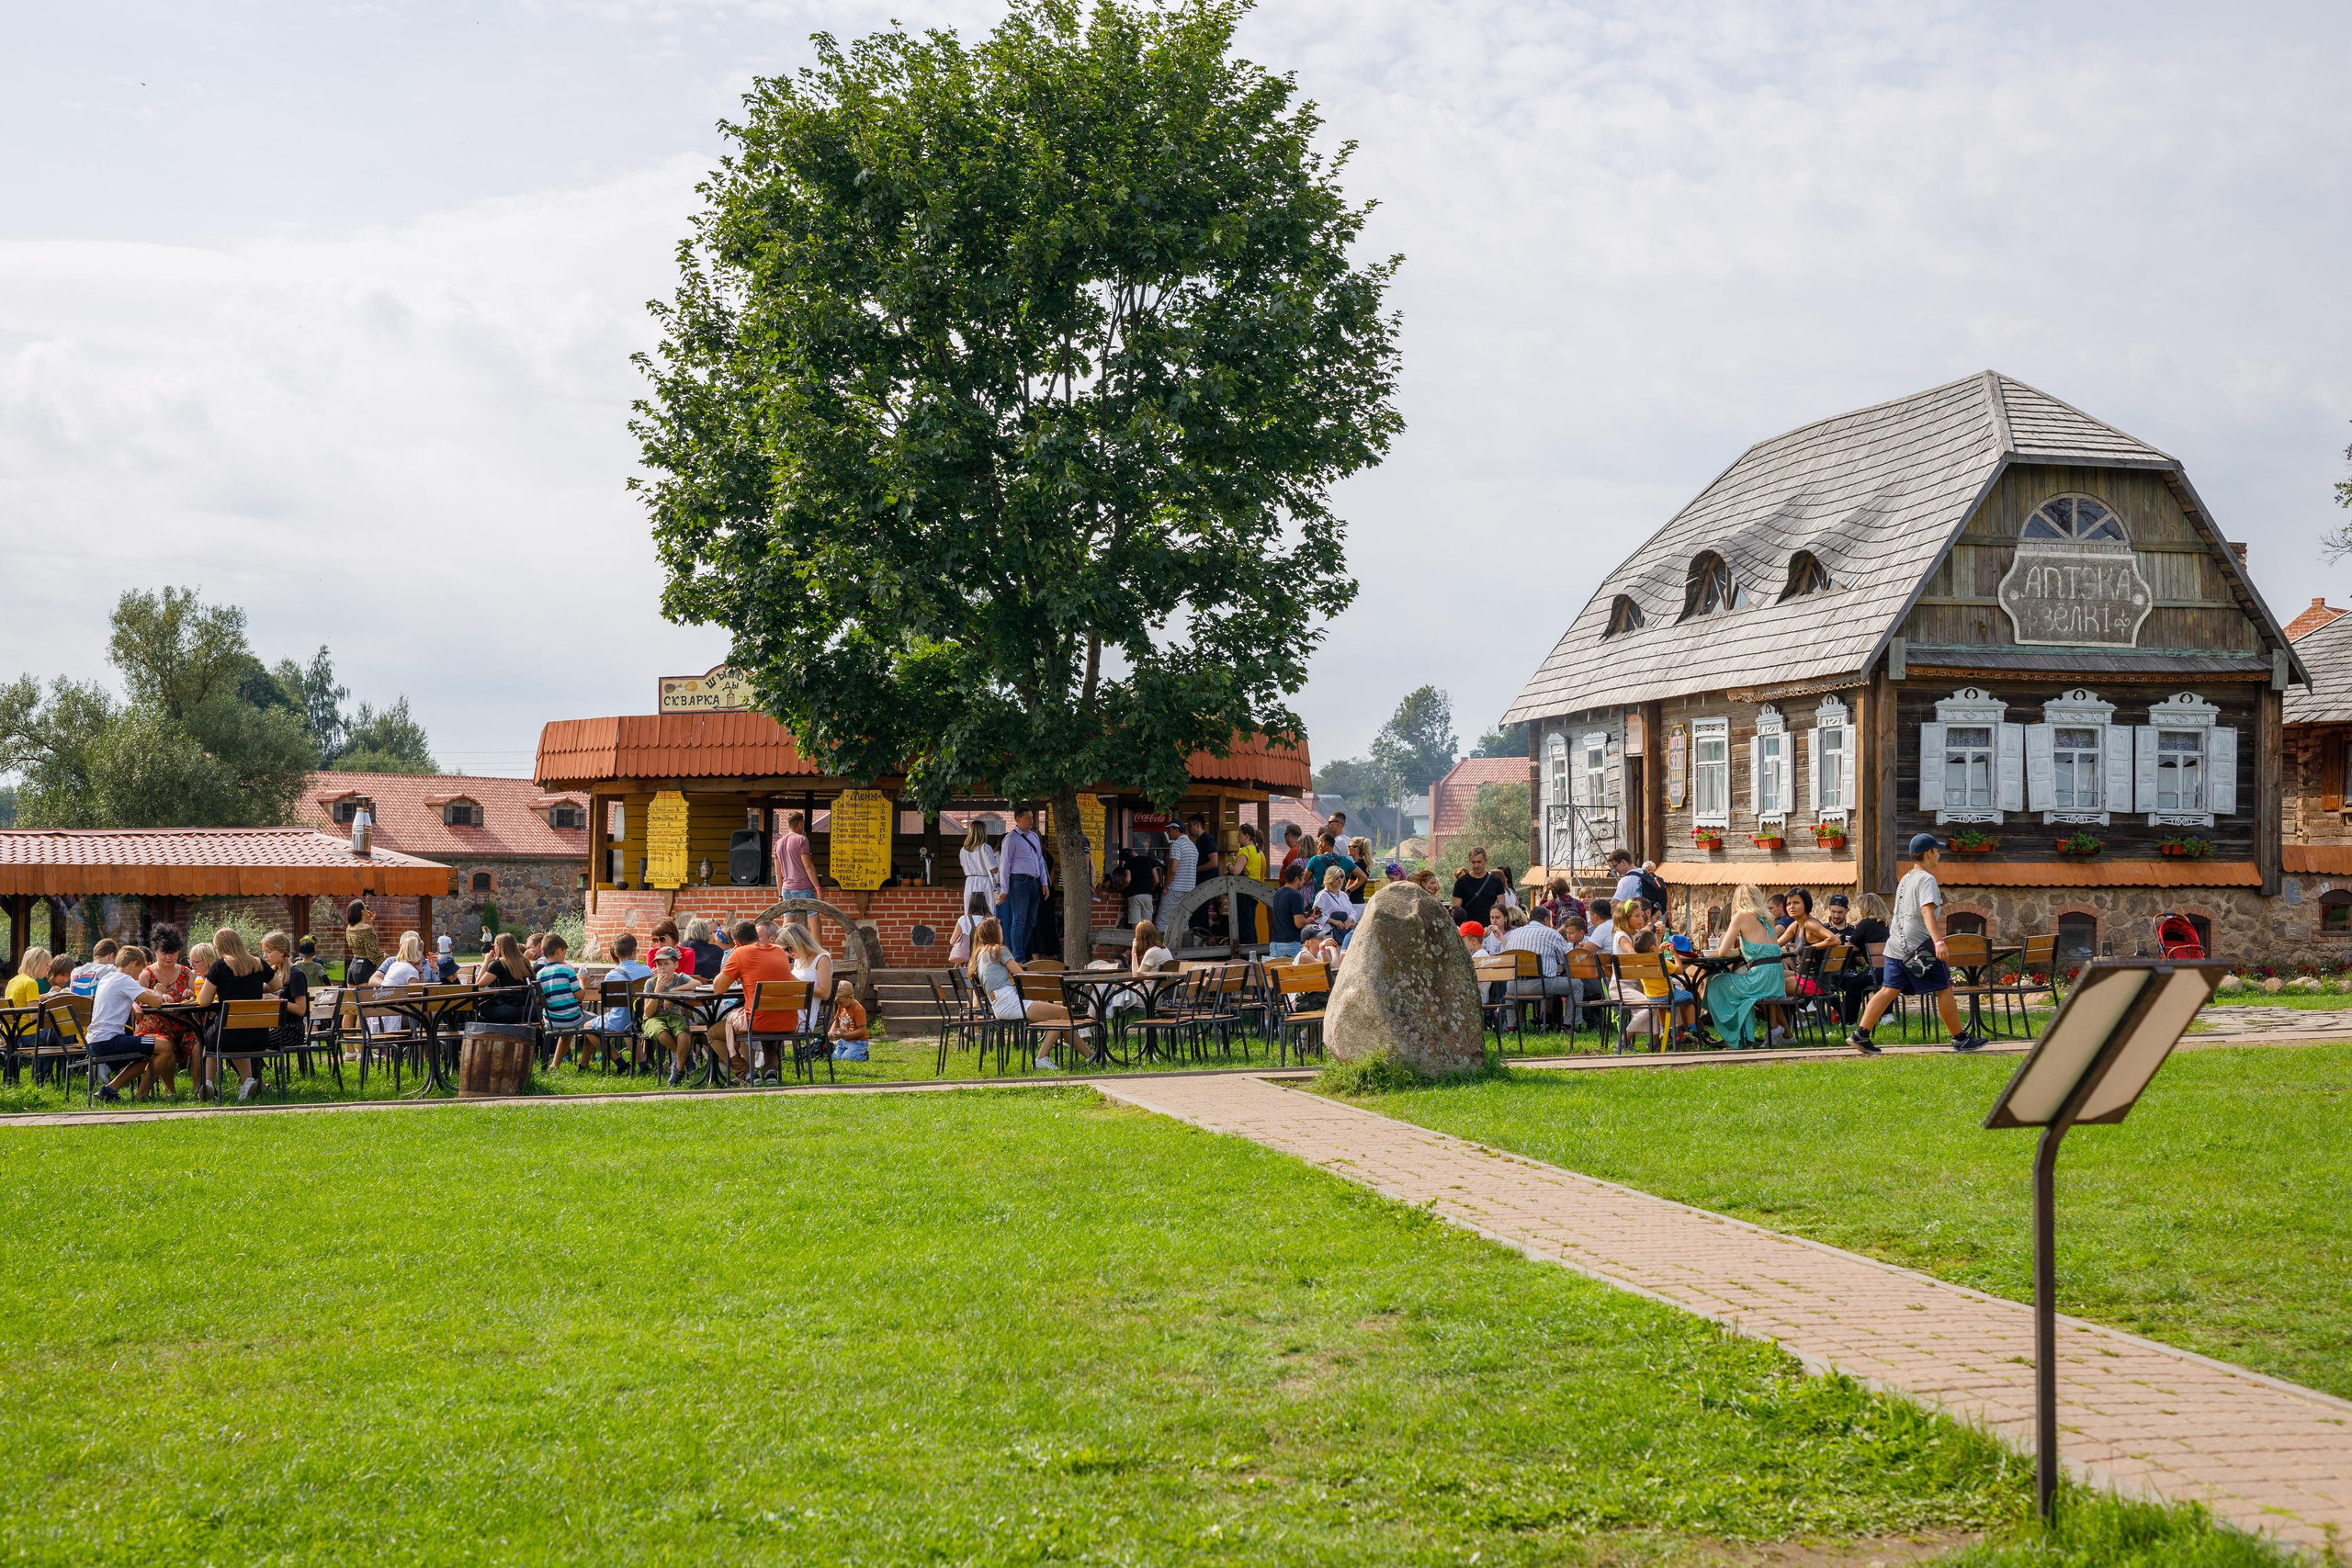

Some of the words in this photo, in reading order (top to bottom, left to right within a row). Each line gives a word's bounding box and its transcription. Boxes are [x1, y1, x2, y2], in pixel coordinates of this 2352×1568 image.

[2022, 565, 2131, 601] АПТЭКА
[722, 681, 739, 691] ДЫ
[663, 694, 720, 706] СКВАРКА
[1134, 811, 1166, 823] Coca-Cola
